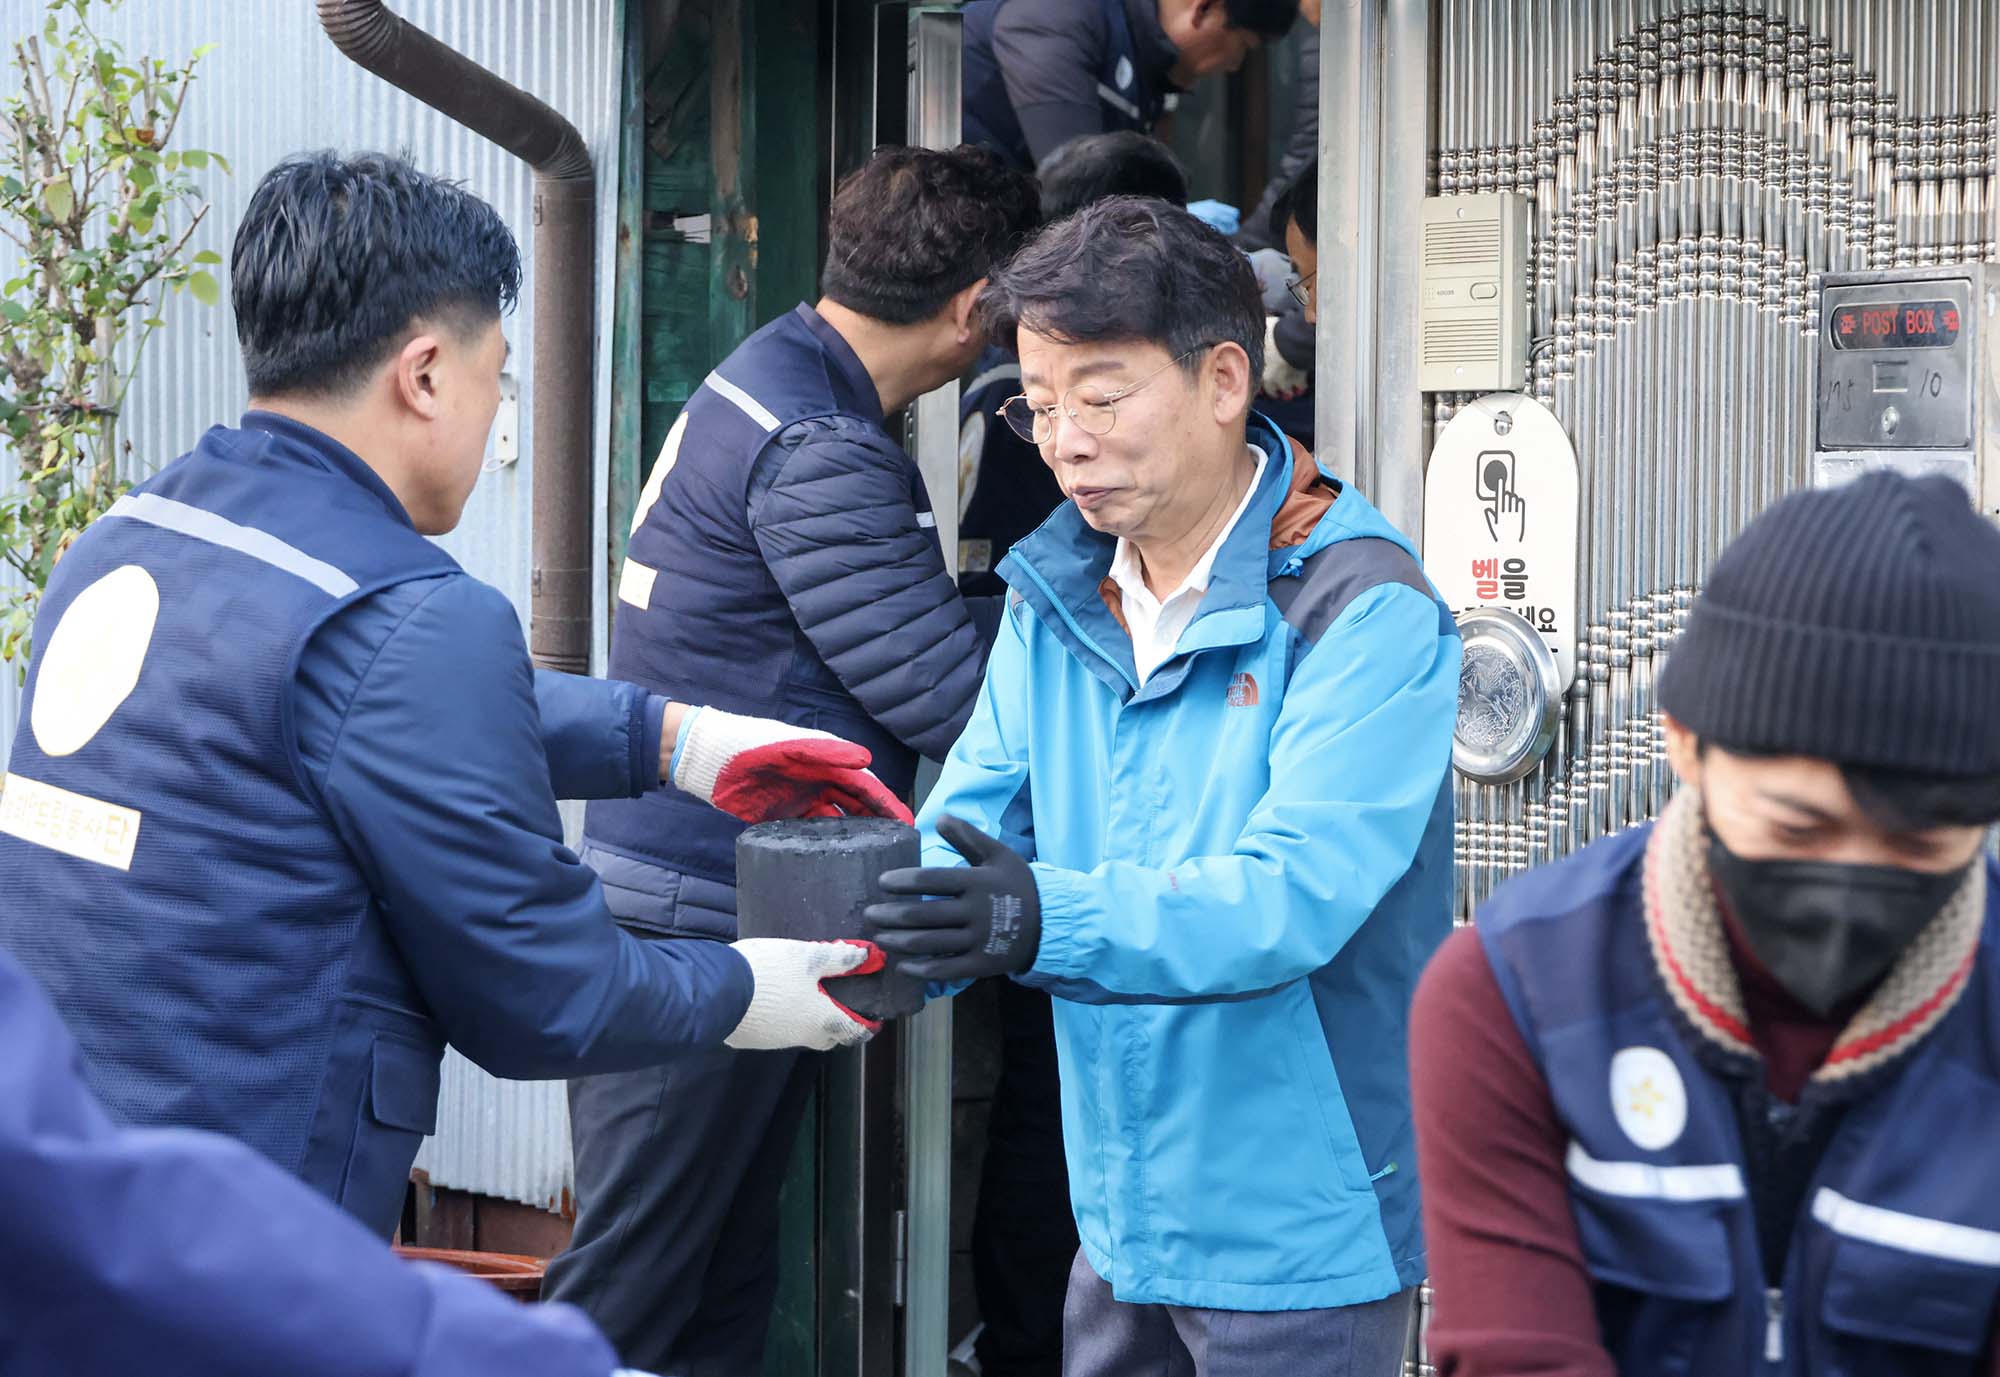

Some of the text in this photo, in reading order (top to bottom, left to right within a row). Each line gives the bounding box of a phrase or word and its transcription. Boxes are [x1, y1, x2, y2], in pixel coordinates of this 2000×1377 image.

[1862, 310, 1937, 335] POST BOX
[1472, 558, 1528, 600] 벨을
